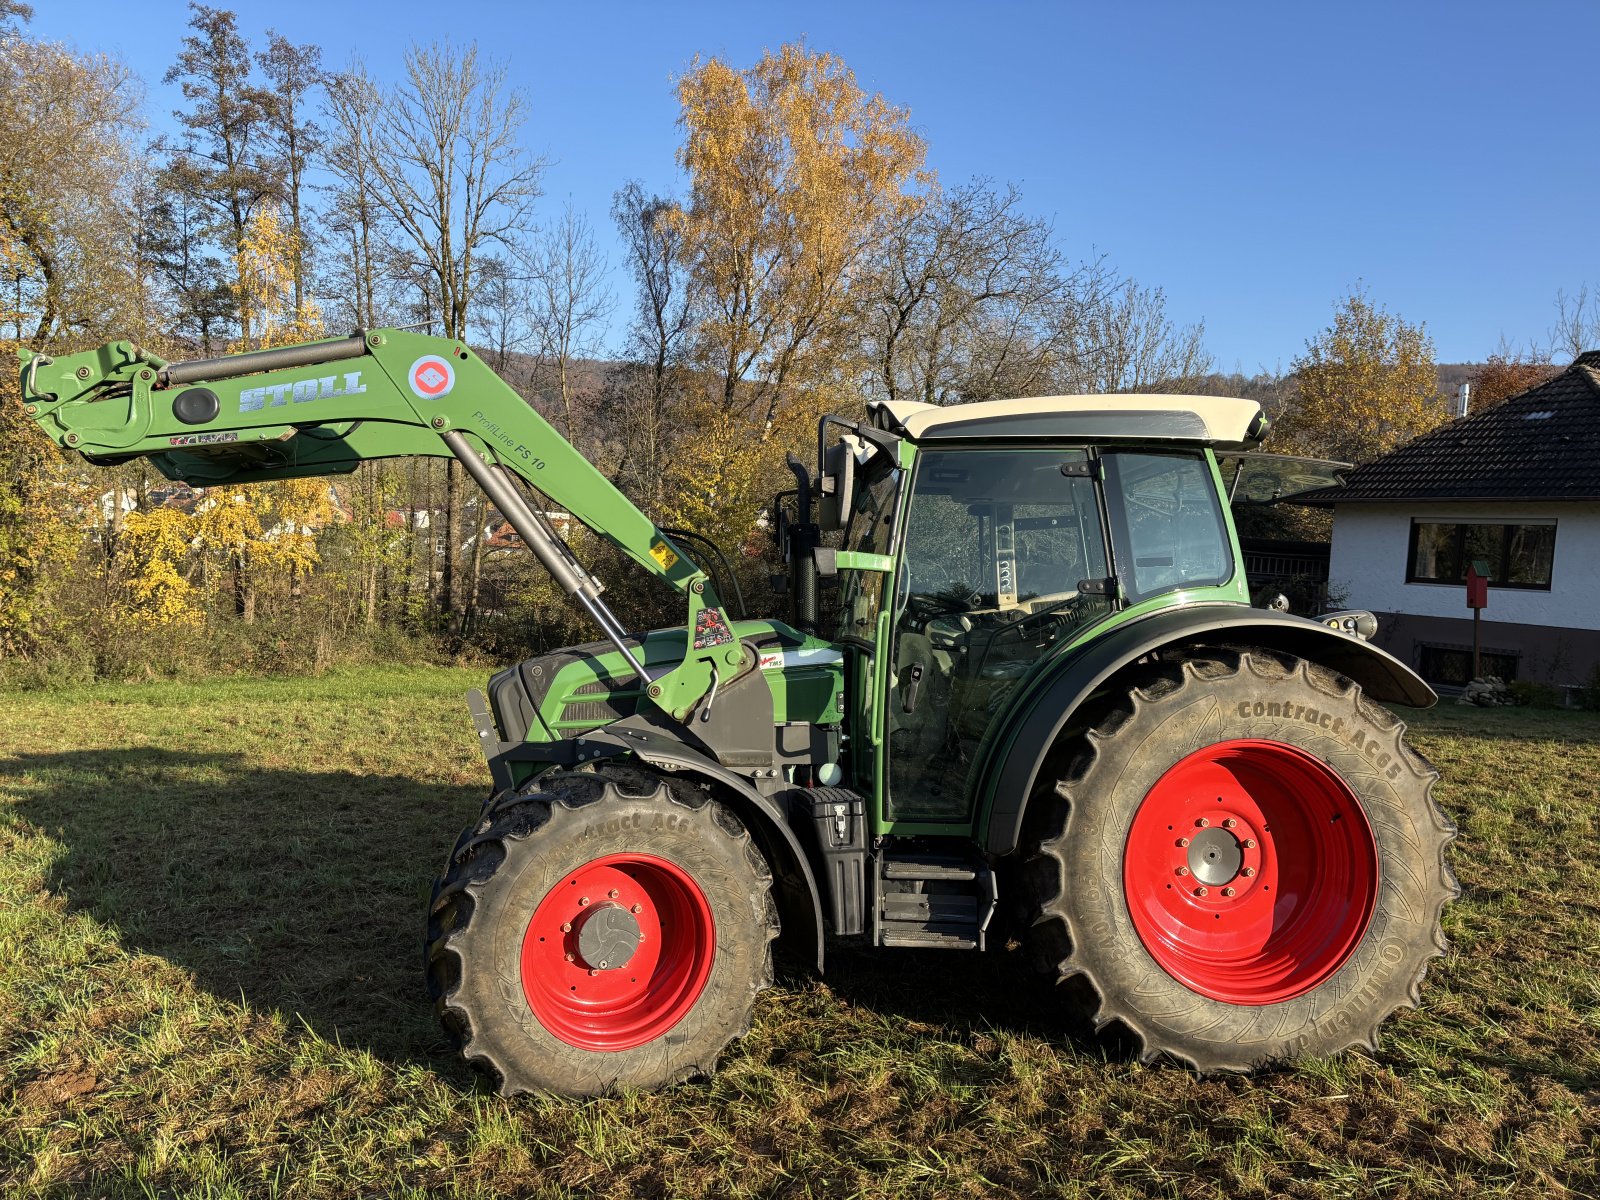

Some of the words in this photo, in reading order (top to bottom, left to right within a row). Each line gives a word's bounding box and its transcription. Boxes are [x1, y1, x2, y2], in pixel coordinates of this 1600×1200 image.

[239, 371, 367, 412] STOLL
[472, 411, 514, 446] ProfiLine
[514, 445, 531, 459] FS
[531, 457, 546, 470] 10
[1238, 700, 1345, 734] contract
[1351, 729, 1402, 780] AC65
